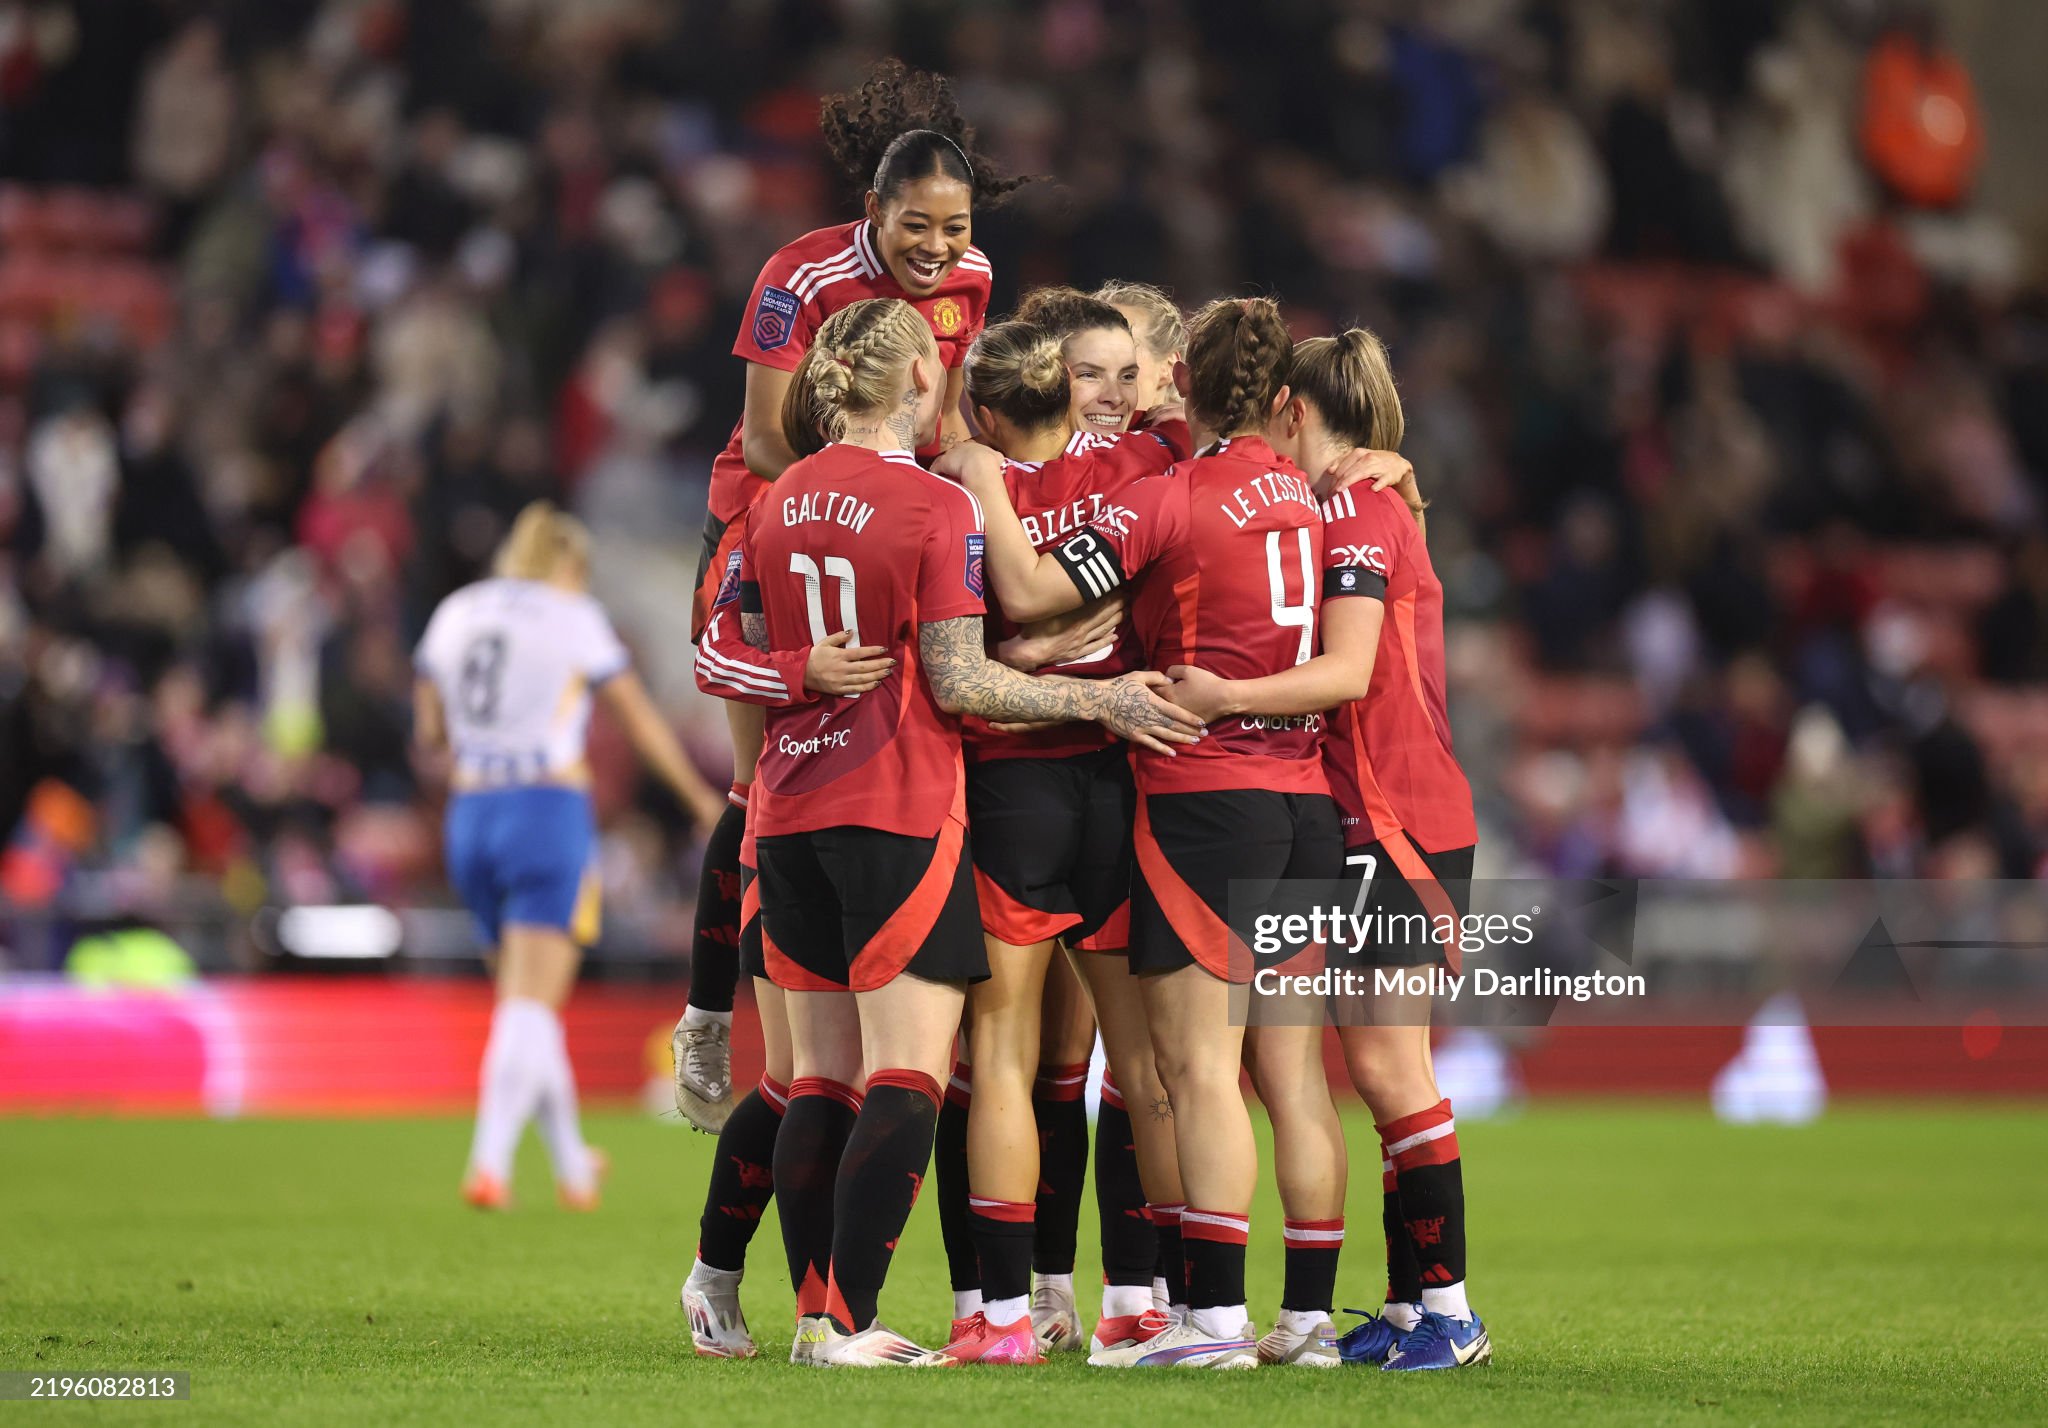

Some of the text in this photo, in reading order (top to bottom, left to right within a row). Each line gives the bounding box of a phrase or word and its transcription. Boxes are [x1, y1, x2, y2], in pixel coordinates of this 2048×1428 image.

[763, 296, 793, 311] WOMEN'S
[783, 491, 875, 535] GALTON
[1221, 487, 1257, 529] LE
[1330, 544, 1386, 570] DXC
[789, 552, 861, 649] 11
[1266, 527, 1315, 666] 4
[1345, 854, 1377, 916] 7
